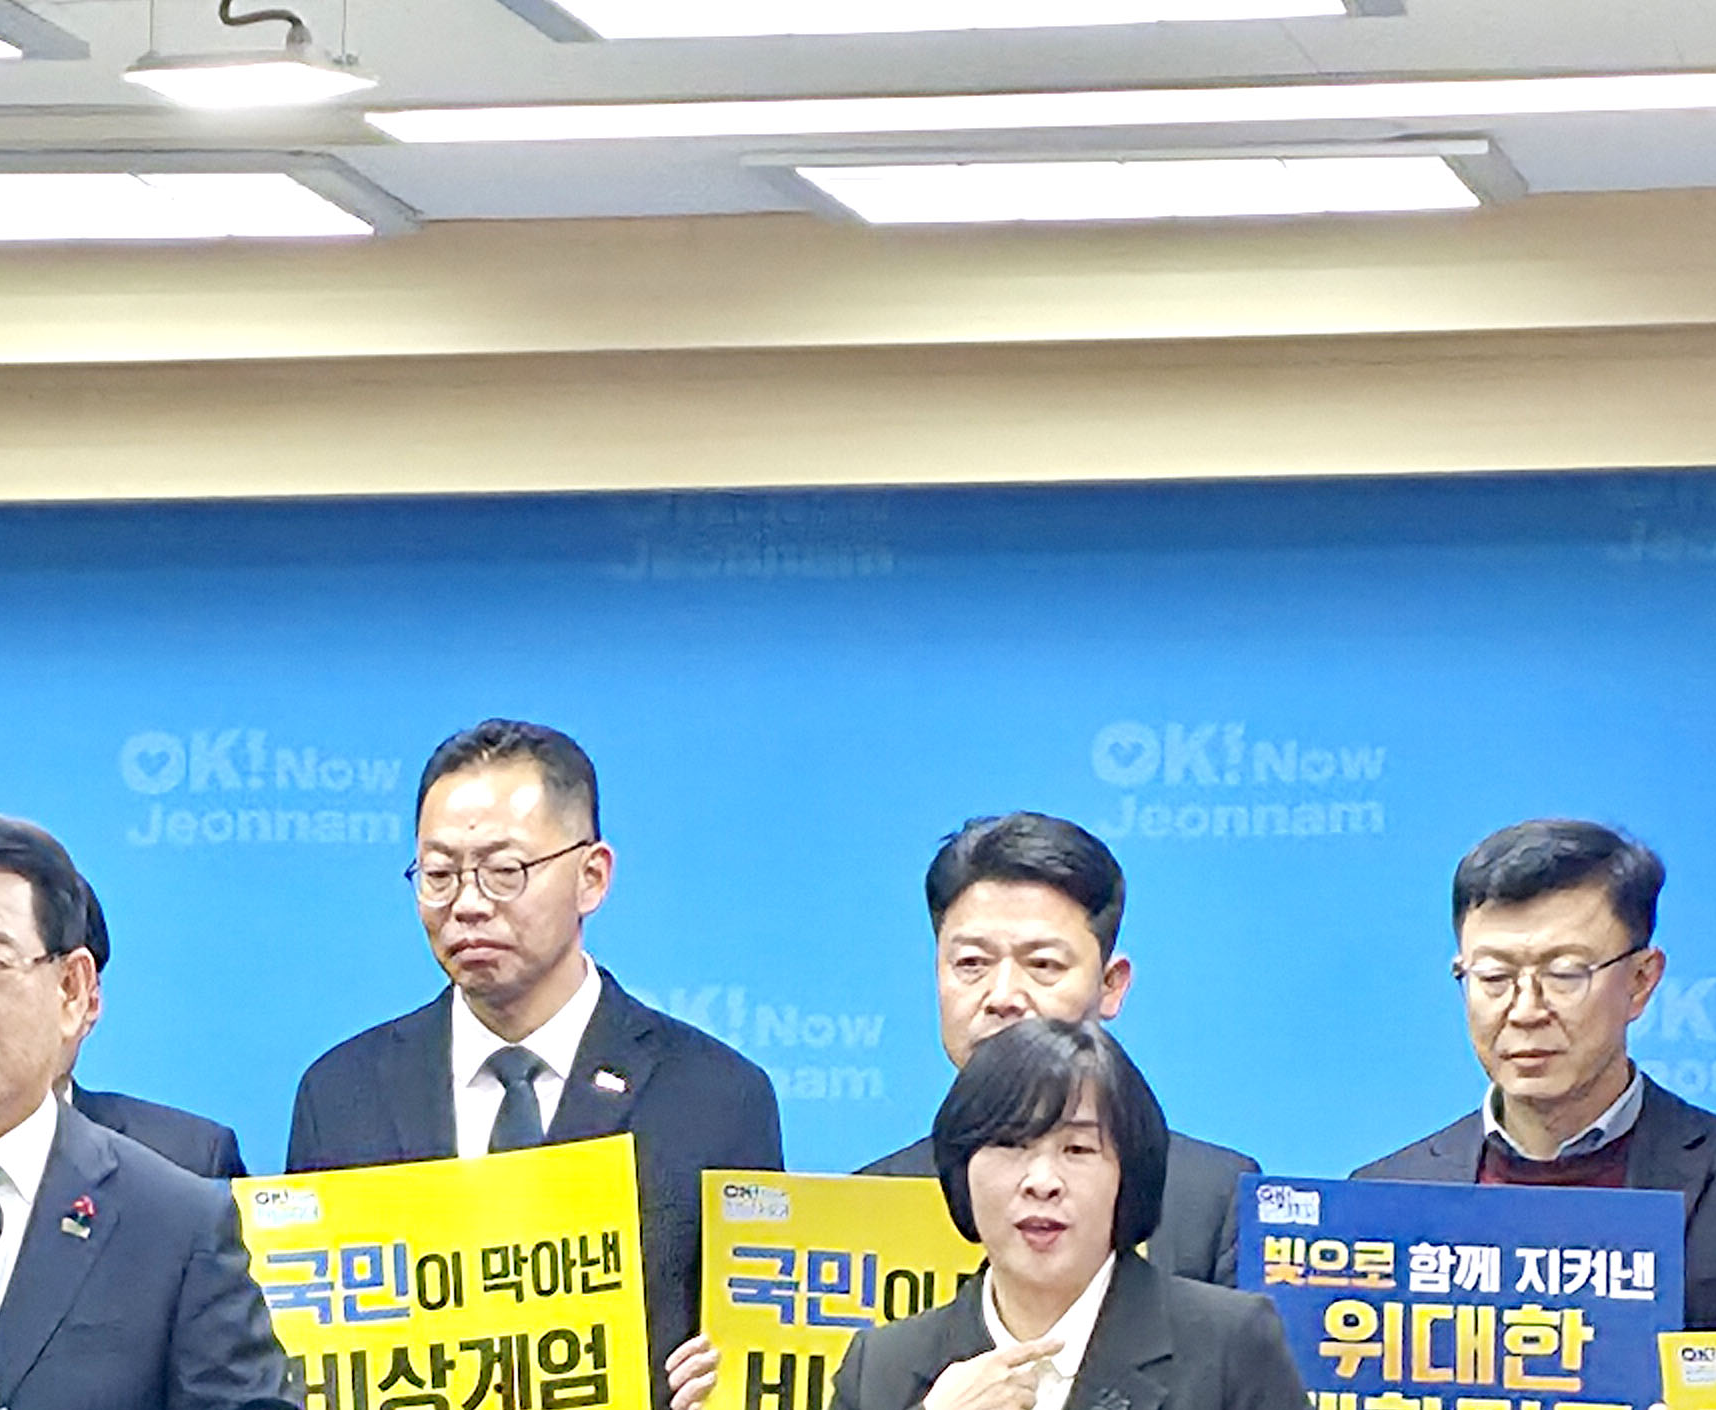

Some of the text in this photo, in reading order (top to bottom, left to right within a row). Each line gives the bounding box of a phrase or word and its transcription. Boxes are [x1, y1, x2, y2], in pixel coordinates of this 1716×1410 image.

[121, 728, 401, 794] OK! Now
[1091, 720, 1387, 786] OK! Now
[125, 803, 401, 846] Jeonnam
[1094, 795, 1385, 837] Jeonnam
[754, 1004, 885, 1048] Now
[264, 1230, 622, 1324] 국민이 막아낸
[728, 1246, 934, 1329] 국민이
[1264, 1235, 1655, 1301] 빛으로 함께 지켜낸
[1319, 1300, 1595, 1393] 위대한
